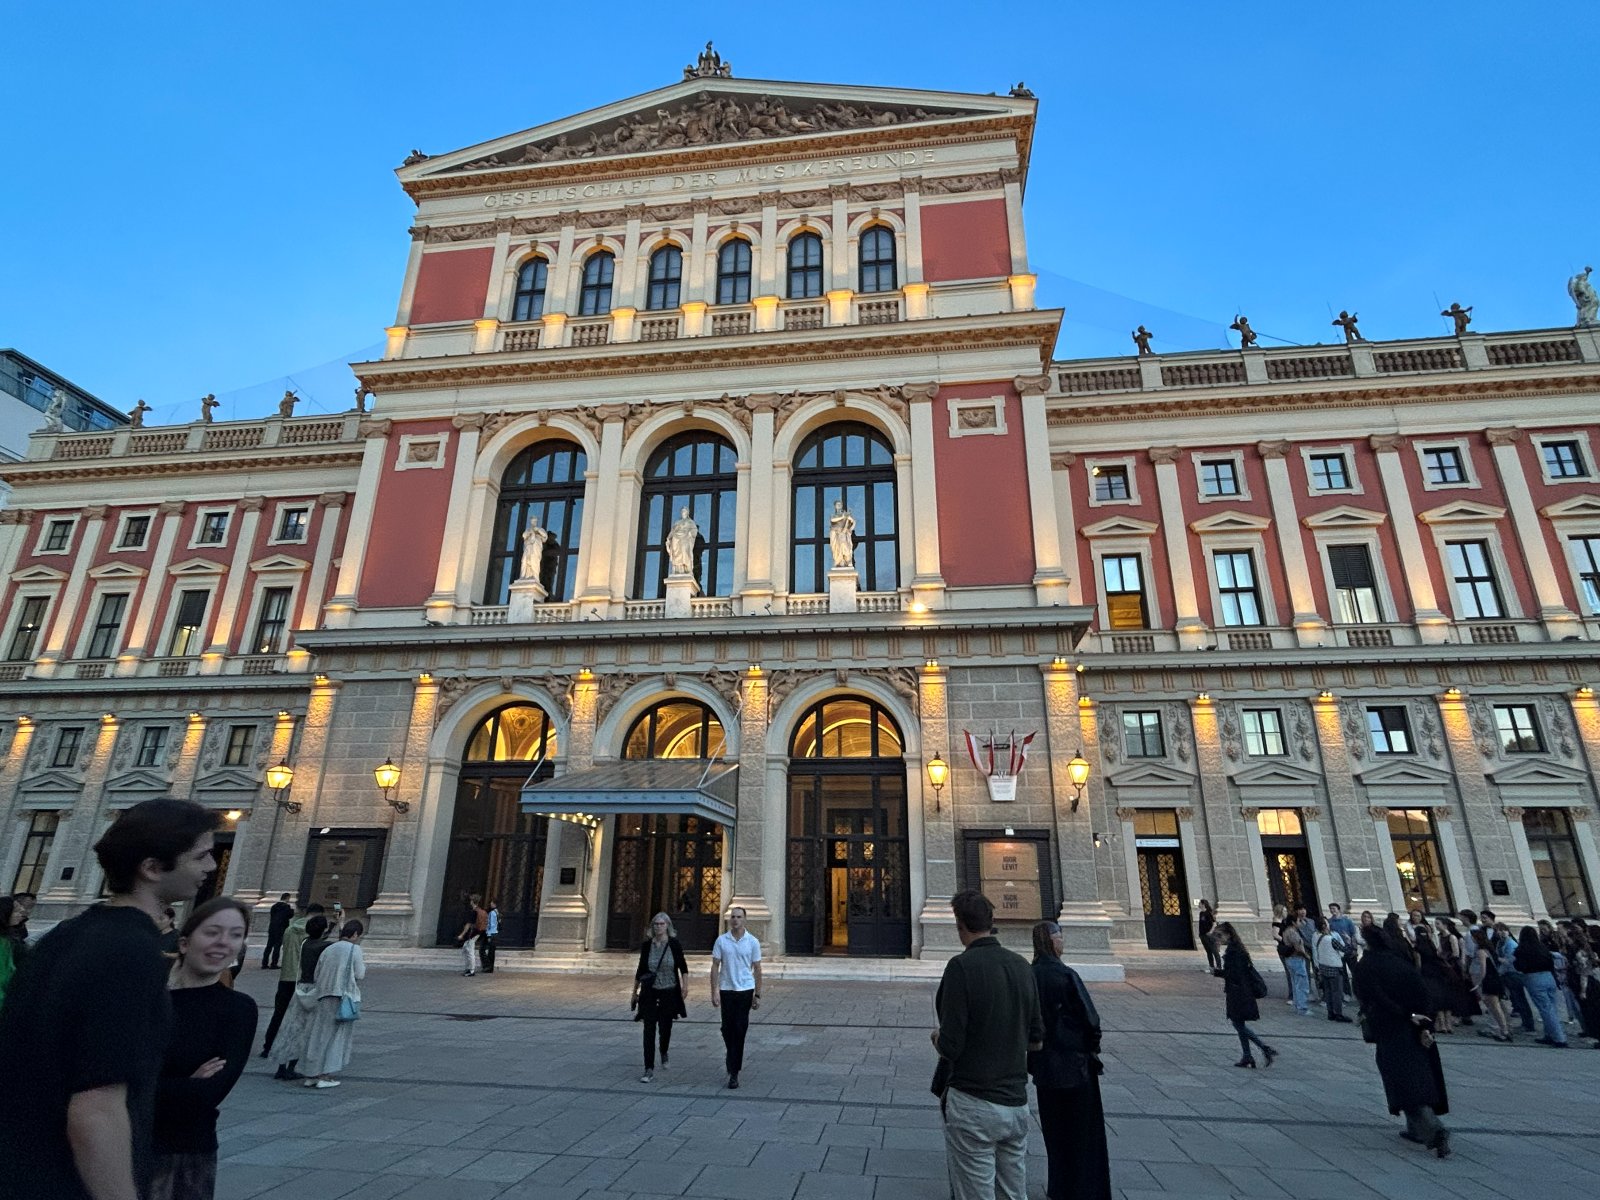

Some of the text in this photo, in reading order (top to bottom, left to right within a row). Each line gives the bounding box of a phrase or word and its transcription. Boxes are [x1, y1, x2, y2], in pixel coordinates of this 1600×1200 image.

[484, 150, 935, 208] GESELLSCHAFT DER MUSIKFREUNDE
[1002, 863, 1018, 871] LEVIT
